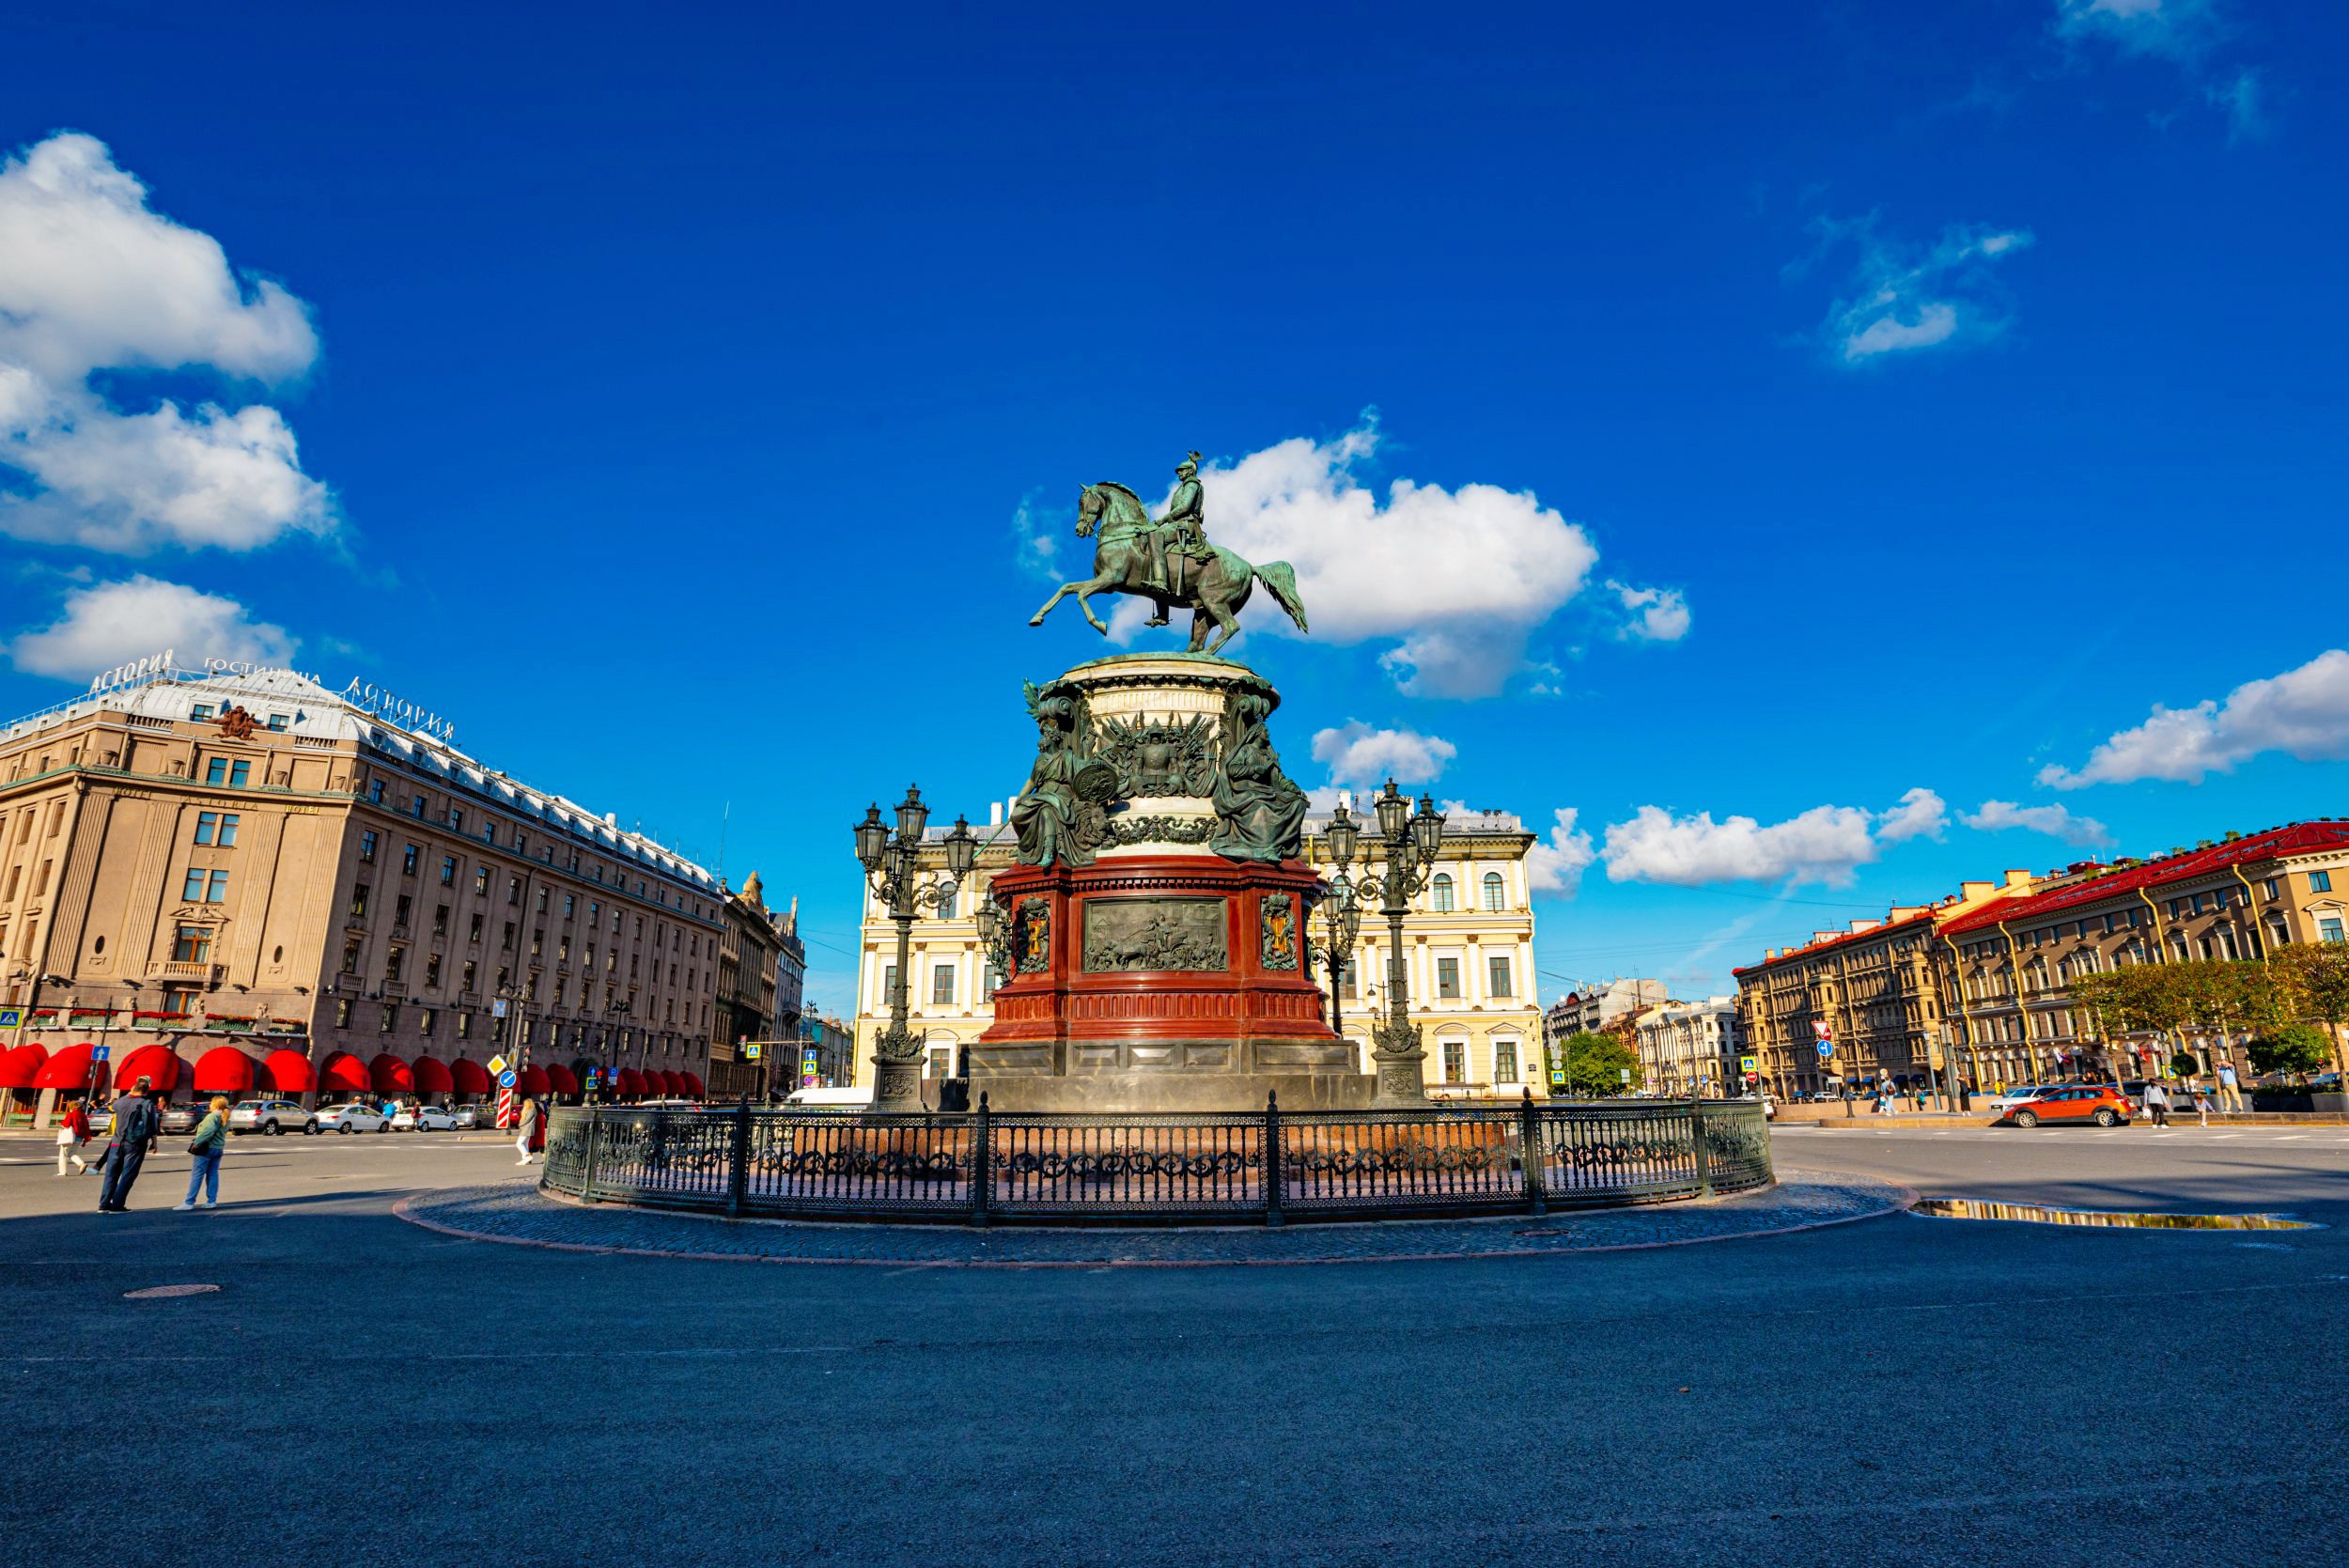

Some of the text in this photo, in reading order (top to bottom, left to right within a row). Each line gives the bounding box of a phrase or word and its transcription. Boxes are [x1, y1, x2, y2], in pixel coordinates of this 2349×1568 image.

[89, 649, 173, 695] АСТОРИЯ
[204, 658, 321, 684] ГОСТИНИЦА
[286, 805, 320, 815] HOTEL
